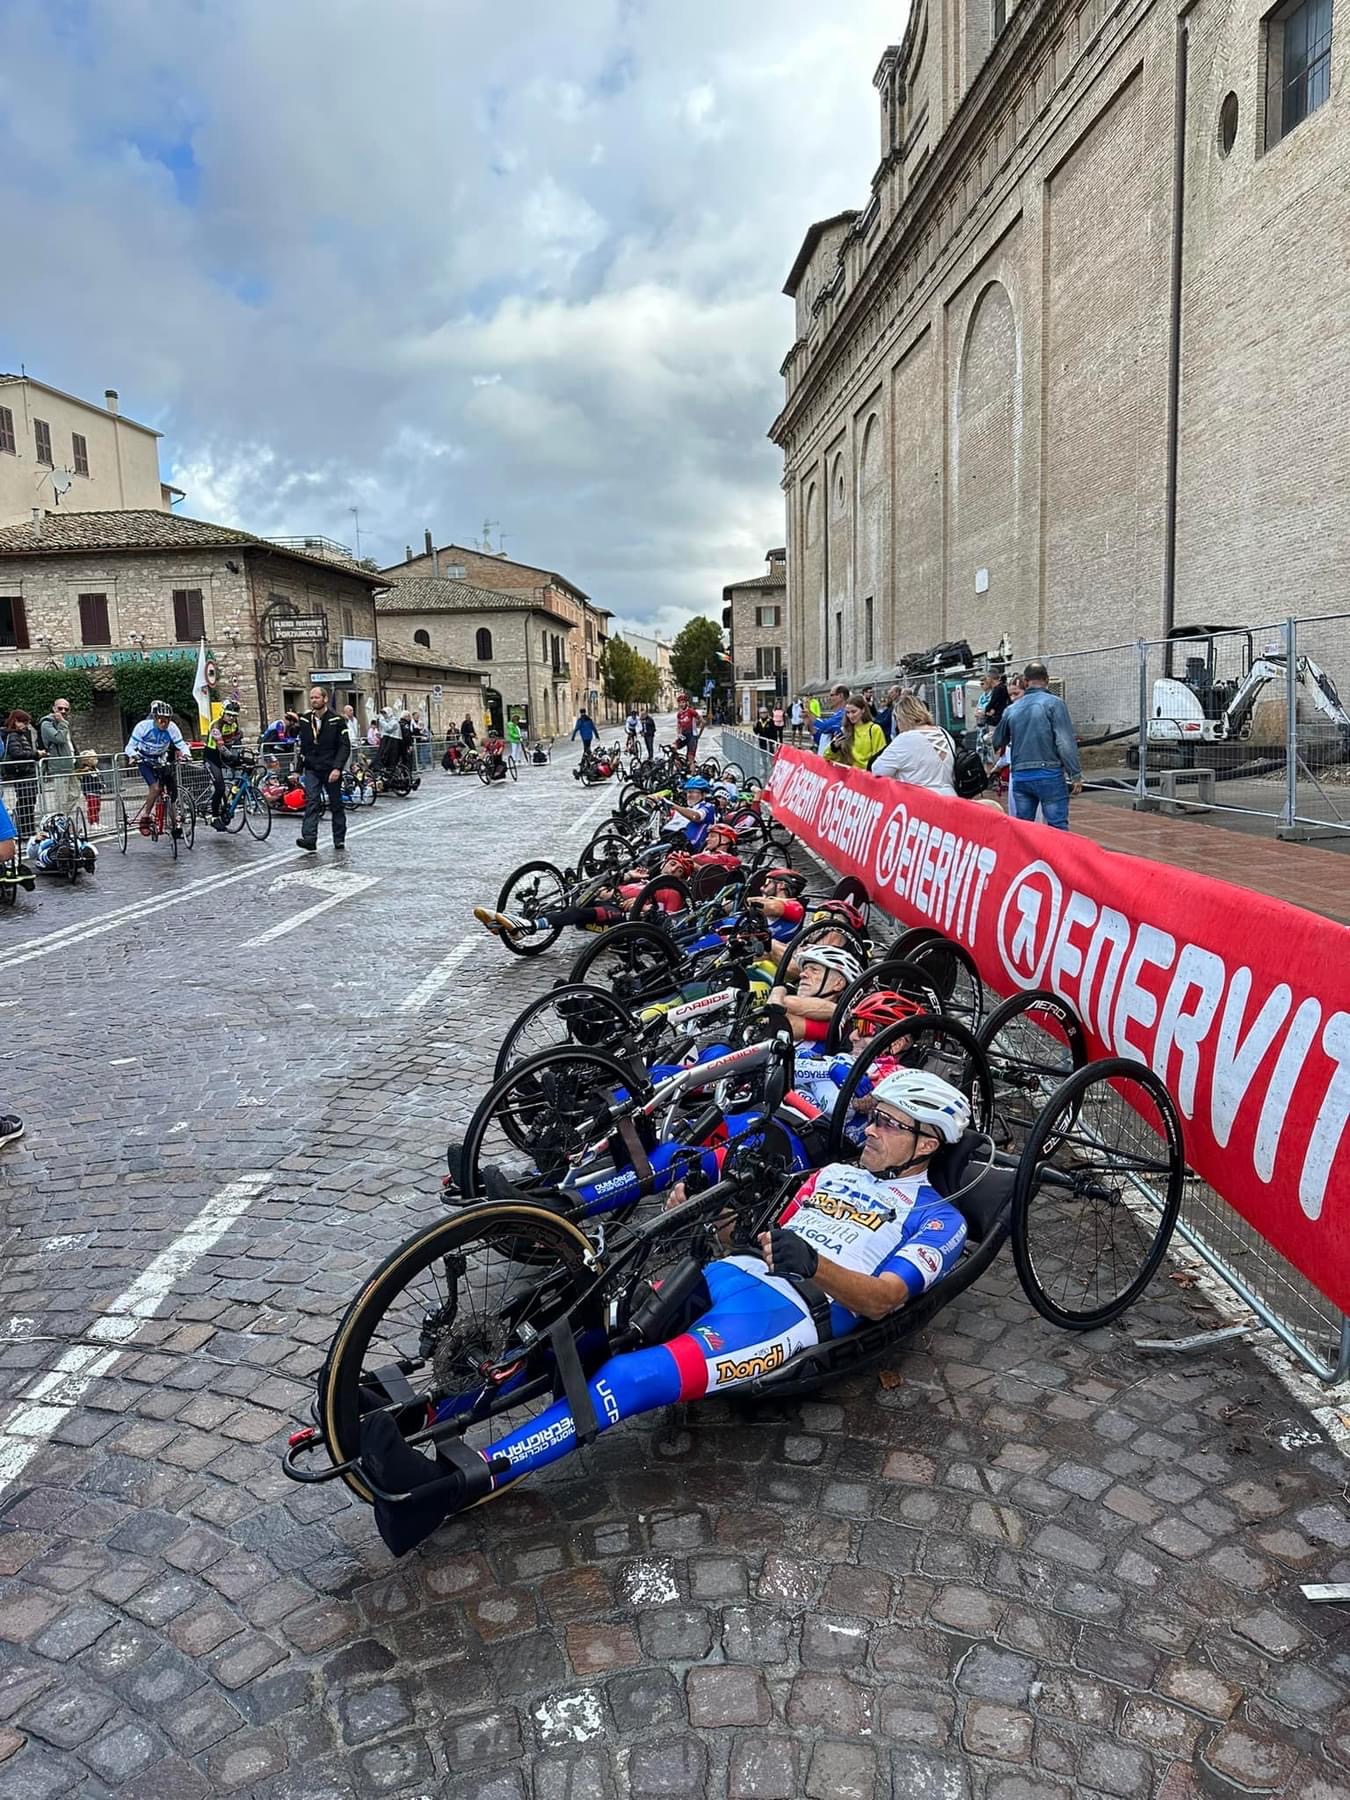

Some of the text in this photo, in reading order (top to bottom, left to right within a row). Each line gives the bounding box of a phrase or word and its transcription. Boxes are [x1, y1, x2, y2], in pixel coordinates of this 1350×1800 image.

[63, 652, 99, 669] BAR
[828, 787, 884, 867] ENERVIT
[895, 817, 997, 948] ENERVIT
[675, 993, 730, 1017] CARBIDE
[1024, 1000, 1067, 1021] AERO
[716, 1343, 784, 1385] Dondi
[595, 1378, 620, 1425] UCP
[550, 1425, 577, 1446] NIONE
